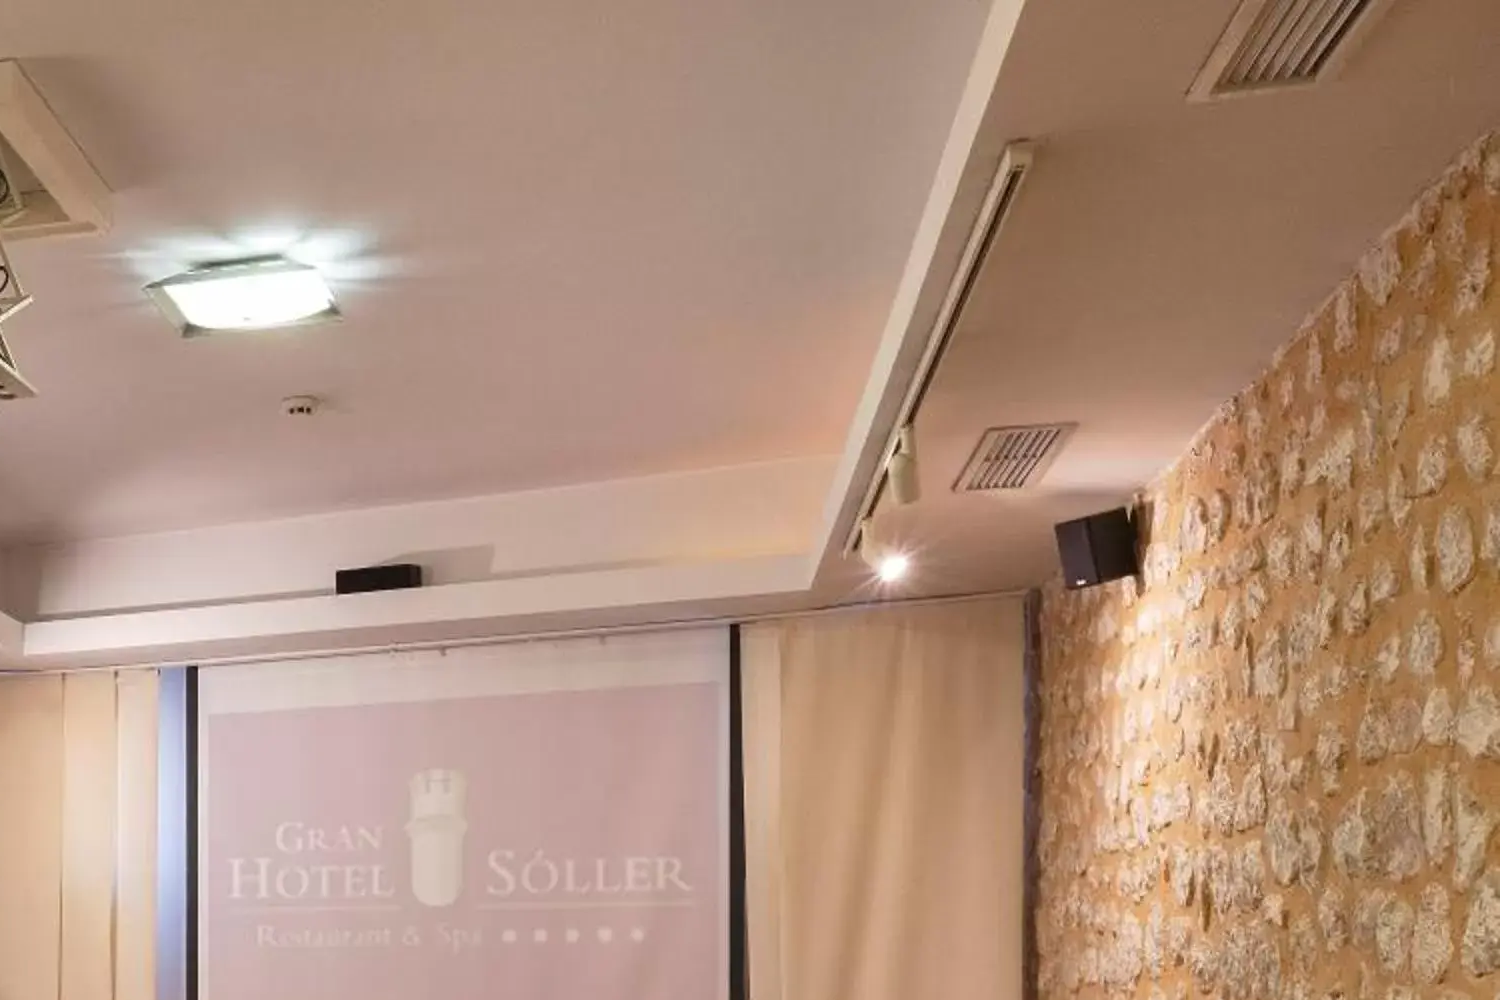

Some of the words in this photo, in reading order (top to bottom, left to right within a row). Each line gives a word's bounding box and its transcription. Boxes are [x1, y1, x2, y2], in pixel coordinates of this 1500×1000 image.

[275, 821, 384, 853] GRAN
[226, 856, 396, 899] HOTEL
[486, 848, 694, 898] SÓLLER
